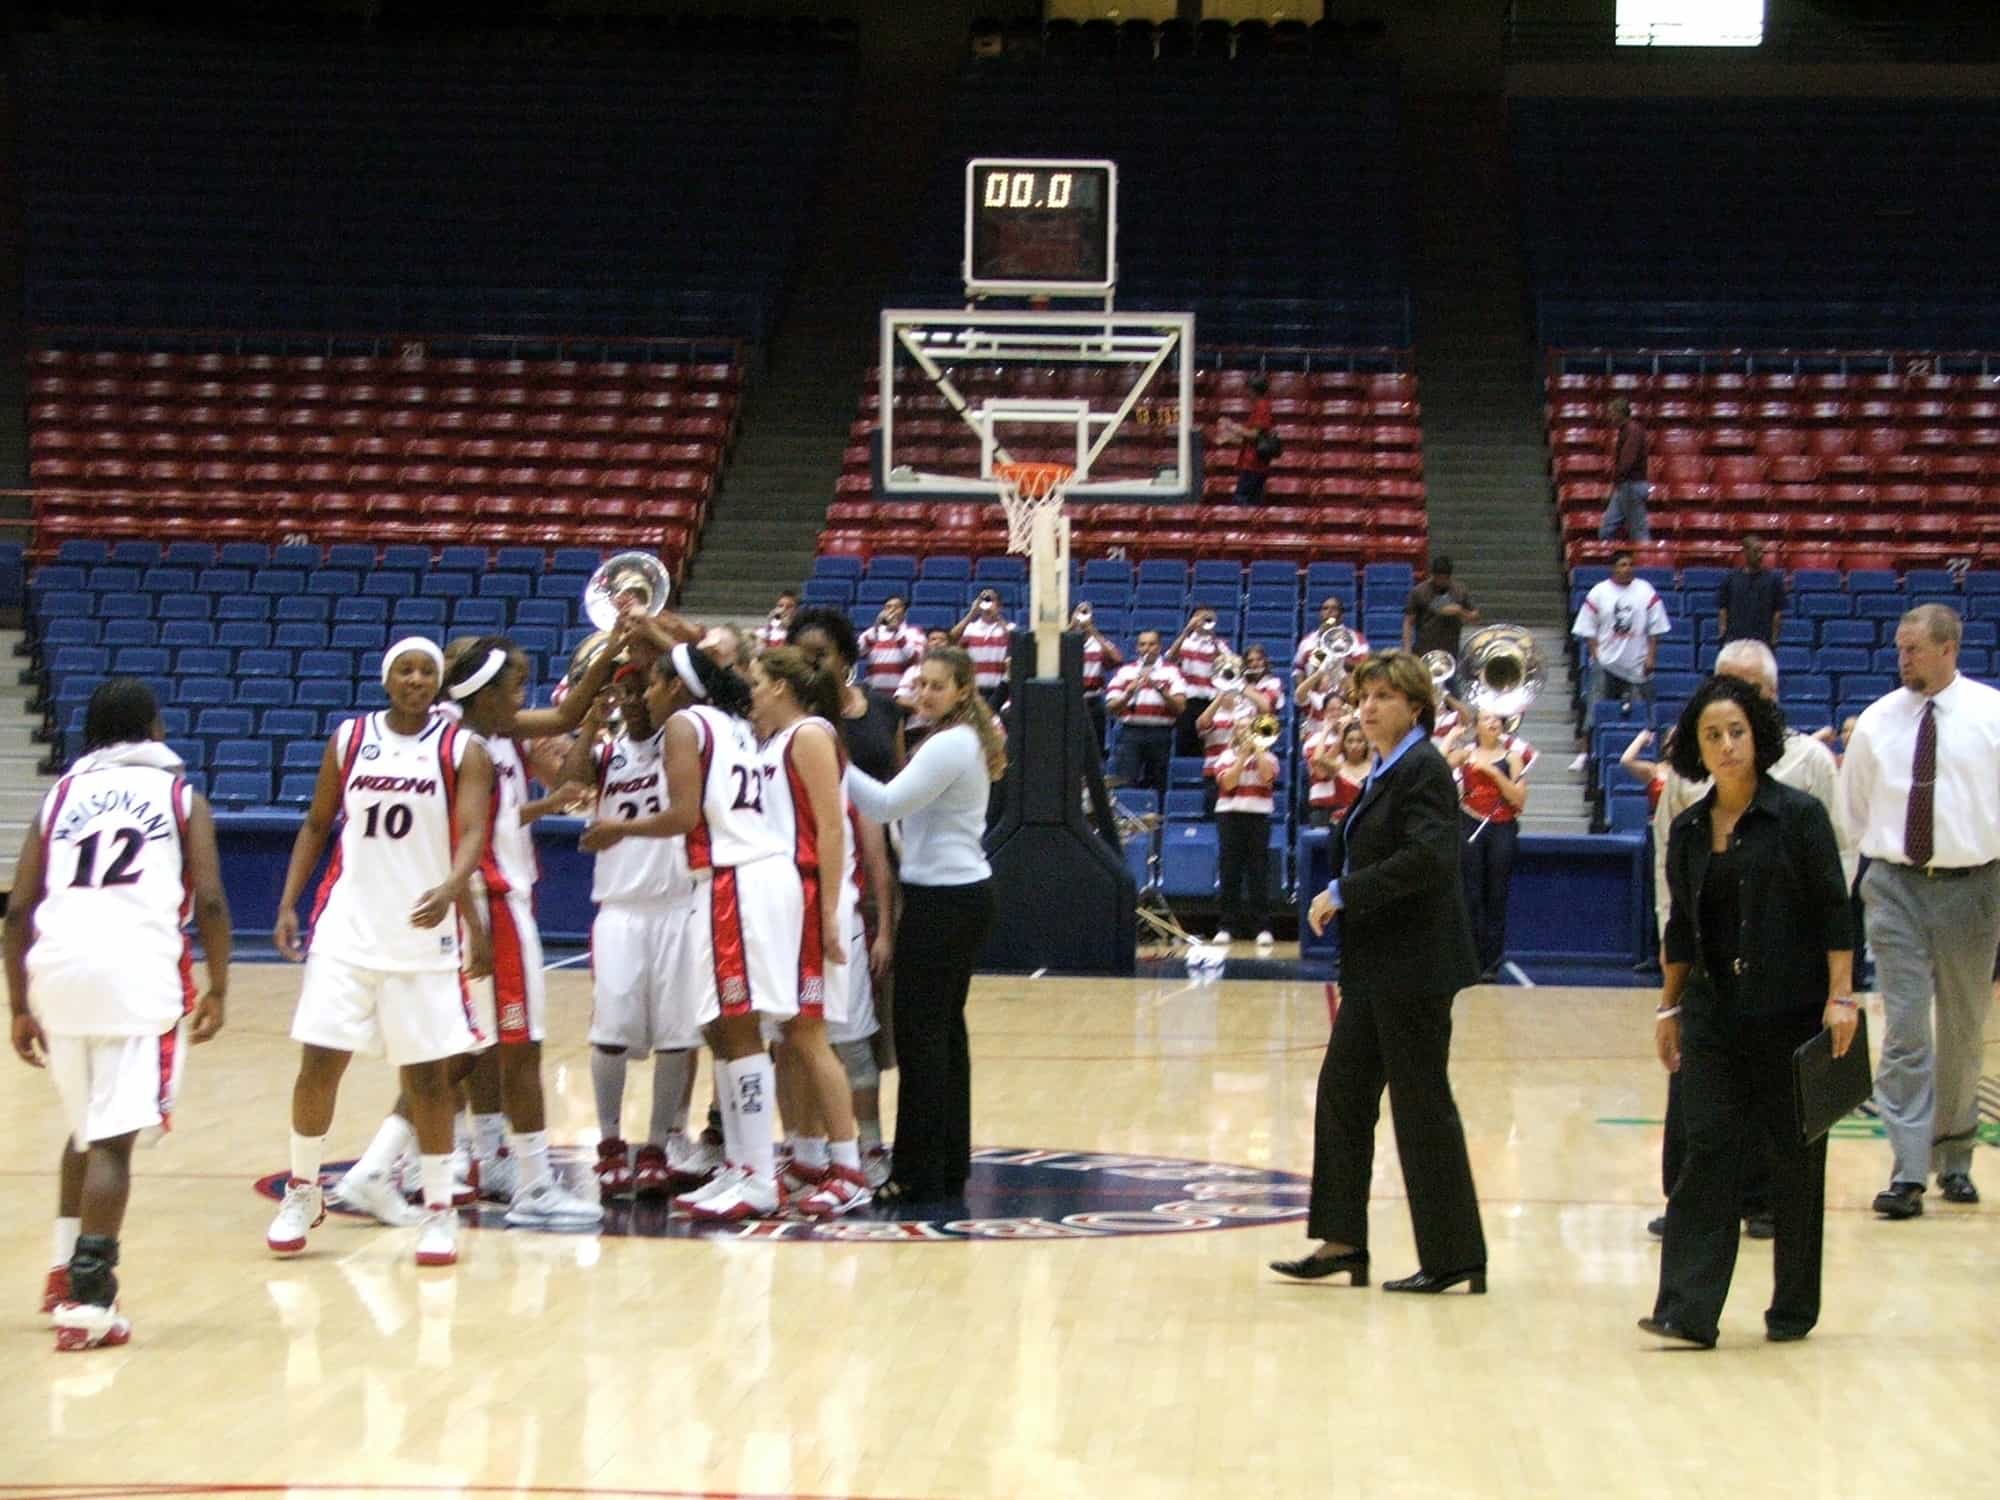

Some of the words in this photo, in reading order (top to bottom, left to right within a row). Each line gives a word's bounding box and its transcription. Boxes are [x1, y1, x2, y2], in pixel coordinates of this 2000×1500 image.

[984, 172, 1072, 208] 00.0
[349, 775, 437, 796] ARIZONA
[364, 801, 413, 840] 10
[68, 827, 145, 888] 12
